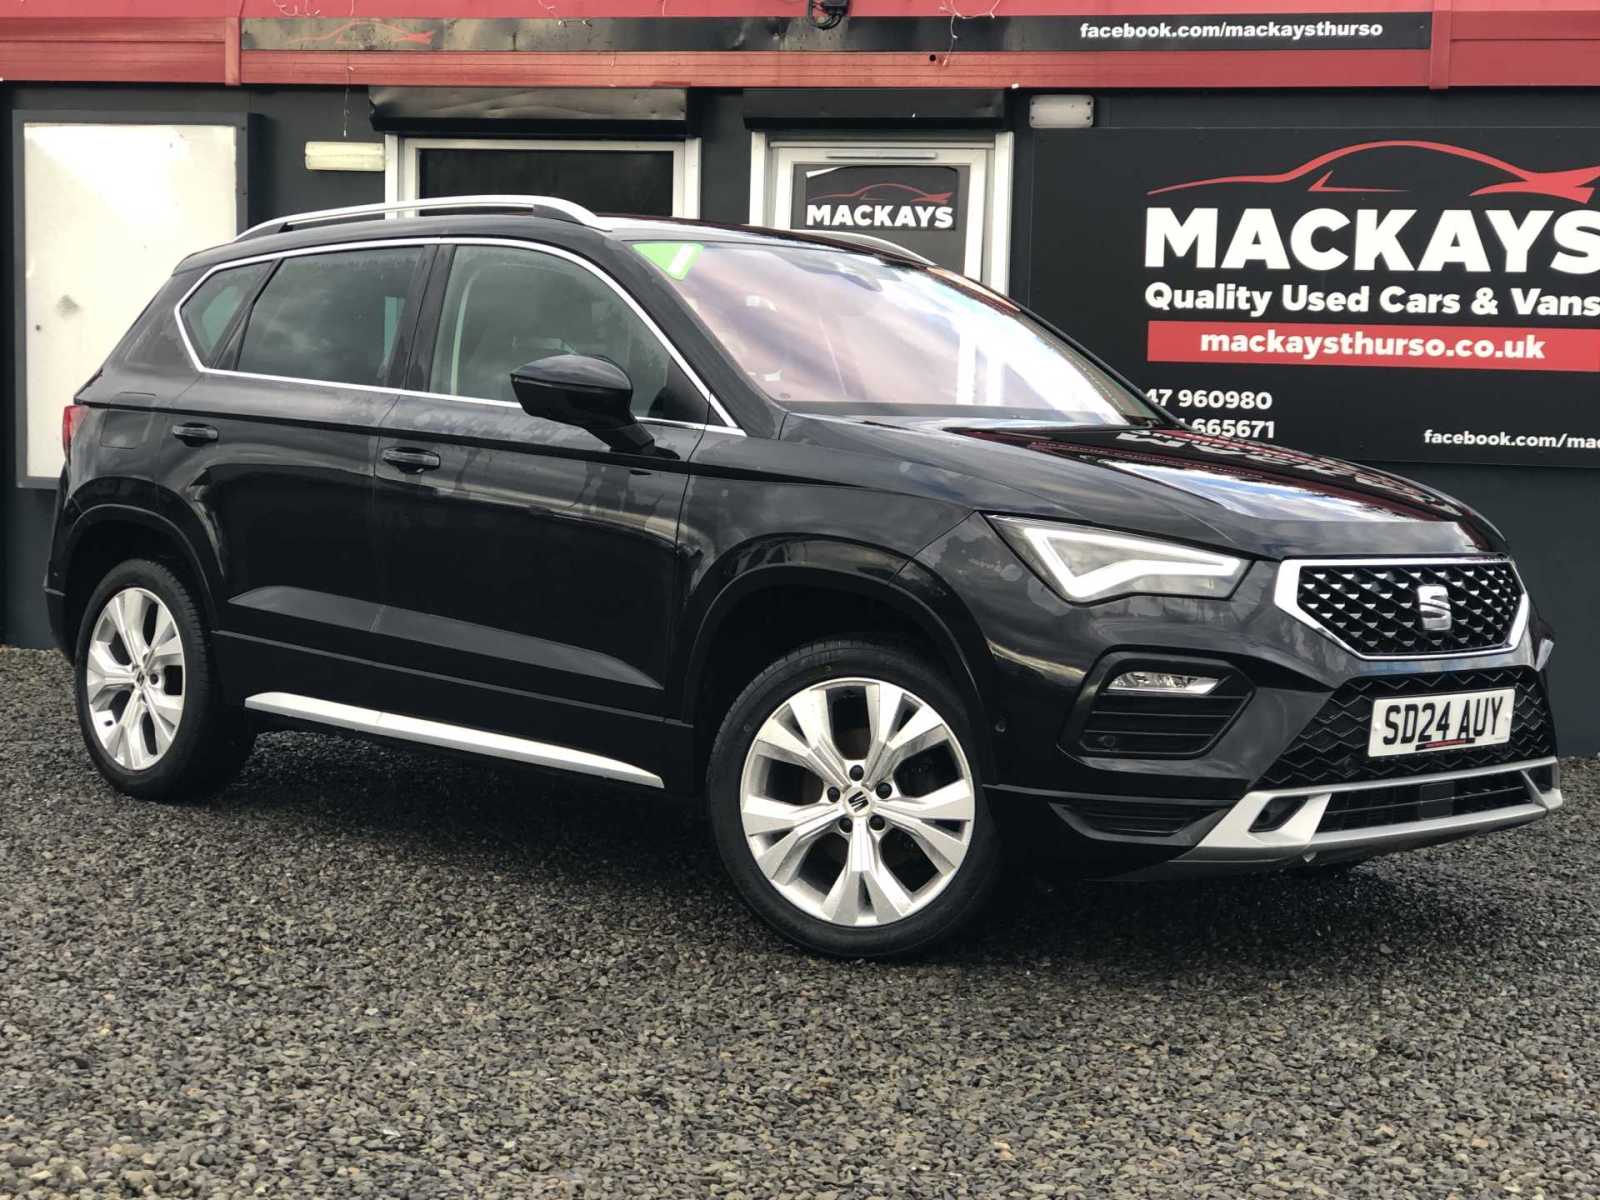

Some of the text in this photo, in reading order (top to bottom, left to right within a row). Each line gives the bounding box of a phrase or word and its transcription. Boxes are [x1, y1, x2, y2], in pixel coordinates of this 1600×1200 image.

[1080, 21, 1384, 40] facebook.com/mackaysthurso
[805, 204, 954, 229] MACKAYS
[1144, 207, 1600, 275] MACKAYS
[1144, 281, 1600, 317] Quality Used Cars & Vans
[1200, 328, 1546, 360] mackaysthurso.co.uk
[1177, 389, 1273, 410] 960980
[1383, 696, 1503, 746] SD24 AUY
